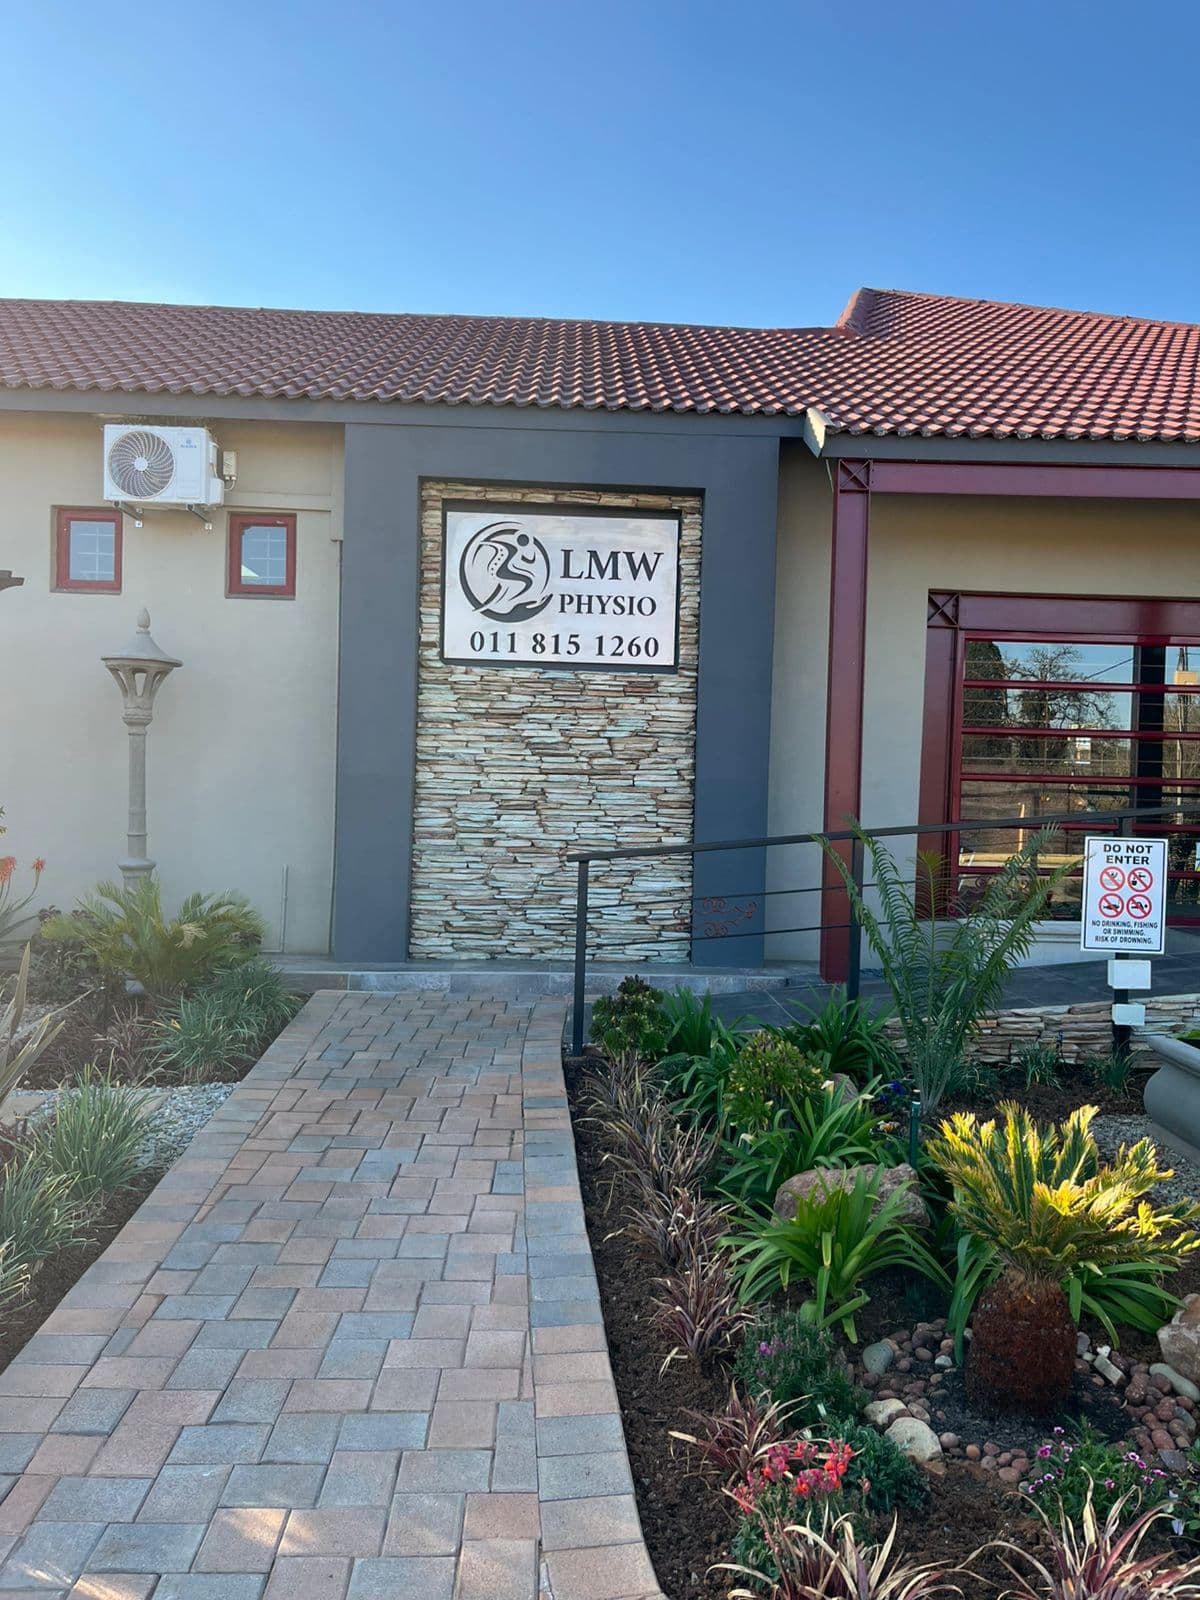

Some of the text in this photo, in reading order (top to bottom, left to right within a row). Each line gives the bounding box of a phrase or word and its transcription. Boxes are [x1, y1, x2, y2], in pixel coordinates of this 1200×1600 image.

[560, 549, 664, 581] LMW
[558, 594, 657, 617] PHYSIO
[470, 631, 659, 657] 011 815 1260
[1103, 843, 1153, 854] DO NOT
[1106, 855, 1150, 865] ENTER
[1091, 919, 1100, 927] NO
[1133, 921, 1158, 929] FISHING
